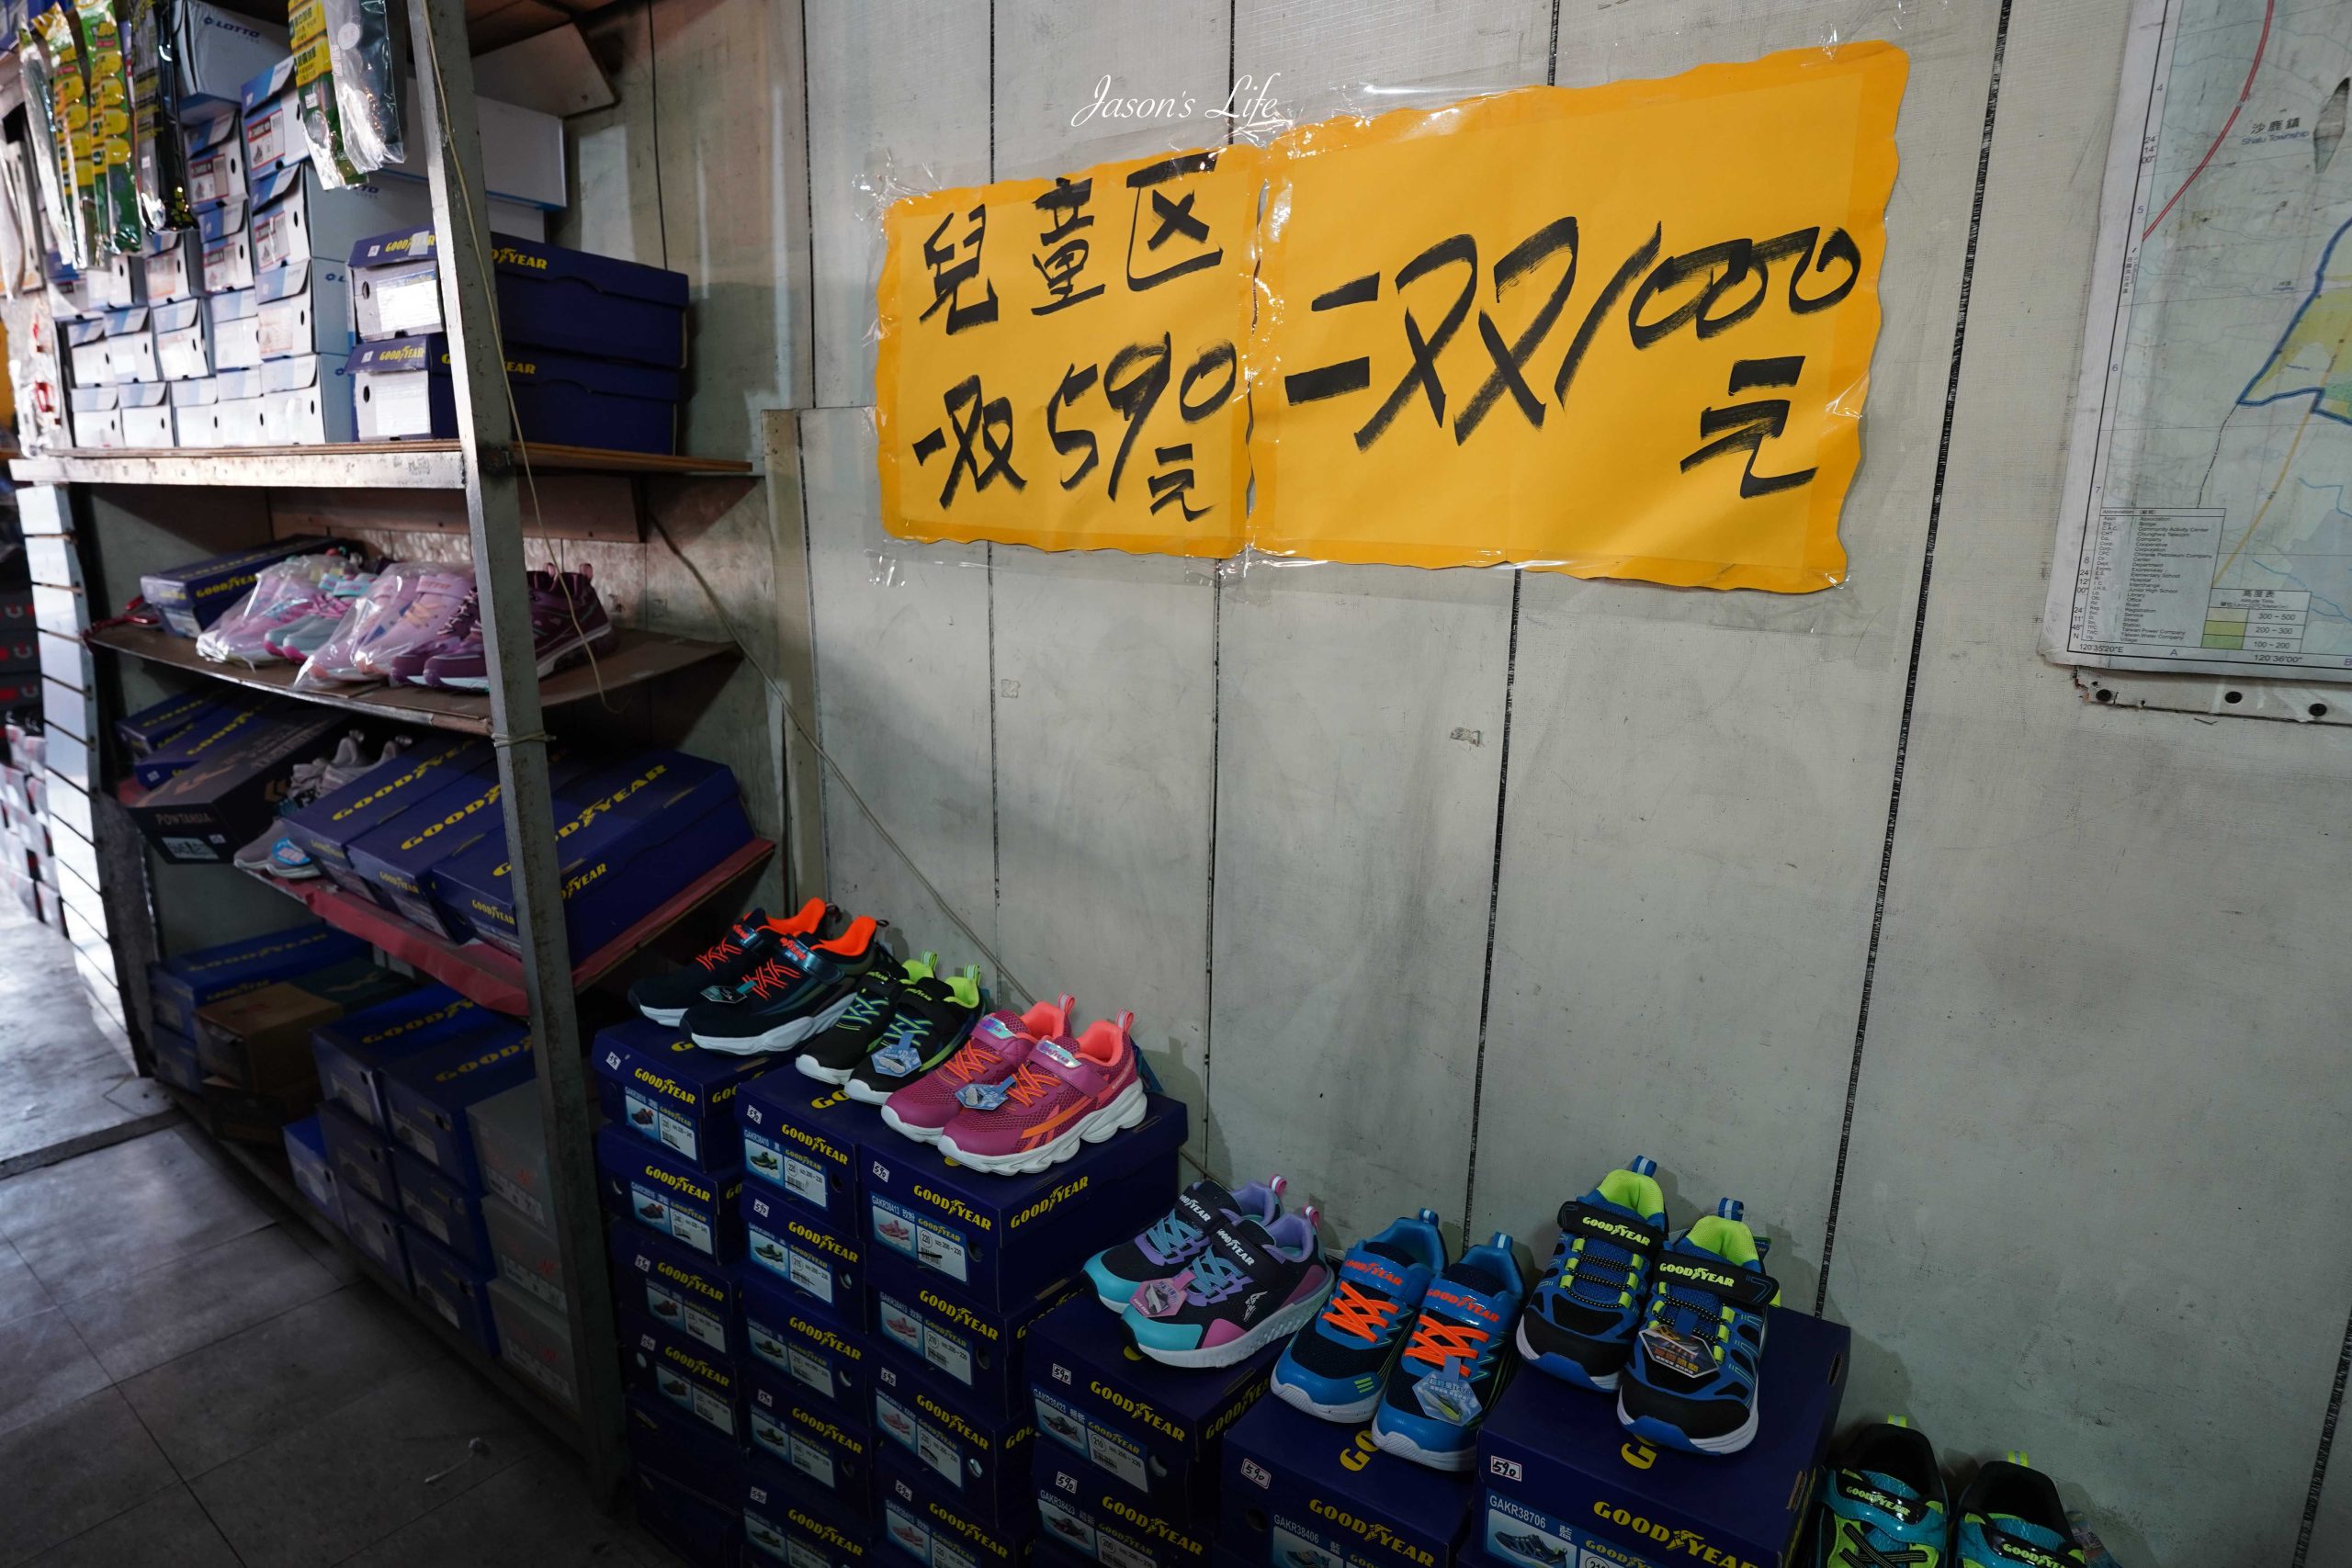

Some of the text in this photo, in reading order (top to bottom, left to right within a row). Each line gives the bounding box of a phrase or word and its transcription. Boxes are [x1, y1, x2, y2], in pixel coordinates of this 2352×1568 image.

[216, 20, 260, 38] LOTTO
[2137, 205, 2144, 214] 5
[379, 344, 425, 362] GOODYEAR
[2095, 486, 2101, 494] 7
[2170, 648, 2177, 658] A
[471, 898, 515, 926] GOODYEAR
[634, 1066, 696, 1106] GOODYEAR
[781, 1123, 850, 1168] GOODYEAR
[645, 1165, 712, 1202] GOODYEAR
[912, 1184, 992, 1231] GOODYEAR
[1011, 1176, 1089, 1229] GOODYEAR
[787, 1222, 860, 1264] GOODYEAR
[918, 1218, 961, 1243] GOODYEAR
[1582, 1216, 1651, 1247] GOODYEAR
[656, 1260, 725, 1303] GOODYEAR
[1659, 1262, 1736, 1288] GOODYEAR
[920, 1289, 999, 1341] GOODYEAR
[787, 1315, 863, 1361] GOODYEAR
[664, 1345, 730, 1389] GOODYEAR
[1053, 1366, 1070, 1382] 590
[915, 1393, 989, 1451] GOODYEAR
[1089, 1380, 1187, 1443] GOODYEAR
[1204, 1376, 1270, 1441] GOODYEA
[791, 1406, 865, 1455] GOODYEAR
[1088, 1420, 1140, 1456] GOODYEAR
[1057, 1473, 1076, 1491] 590
[1244, 1462, 1266, 1483] 590
[1492, 1460, 1518, 1478] 590
[1489, 1495, 1546, 1530] GAKR38706
[1845, 1485, 1911, 1517] GOODYEAR
[787, 1508, 865, 1557] GOODYEAR
[928, 1501, 1009, 1559] GOODYEAR
[1102, 1494, 1204, 1558] GOODYEAR
[1273, 1514, 1320, 1545] GAKR38406
[1308, 1498, 1435, 1568] GOODYEAR
